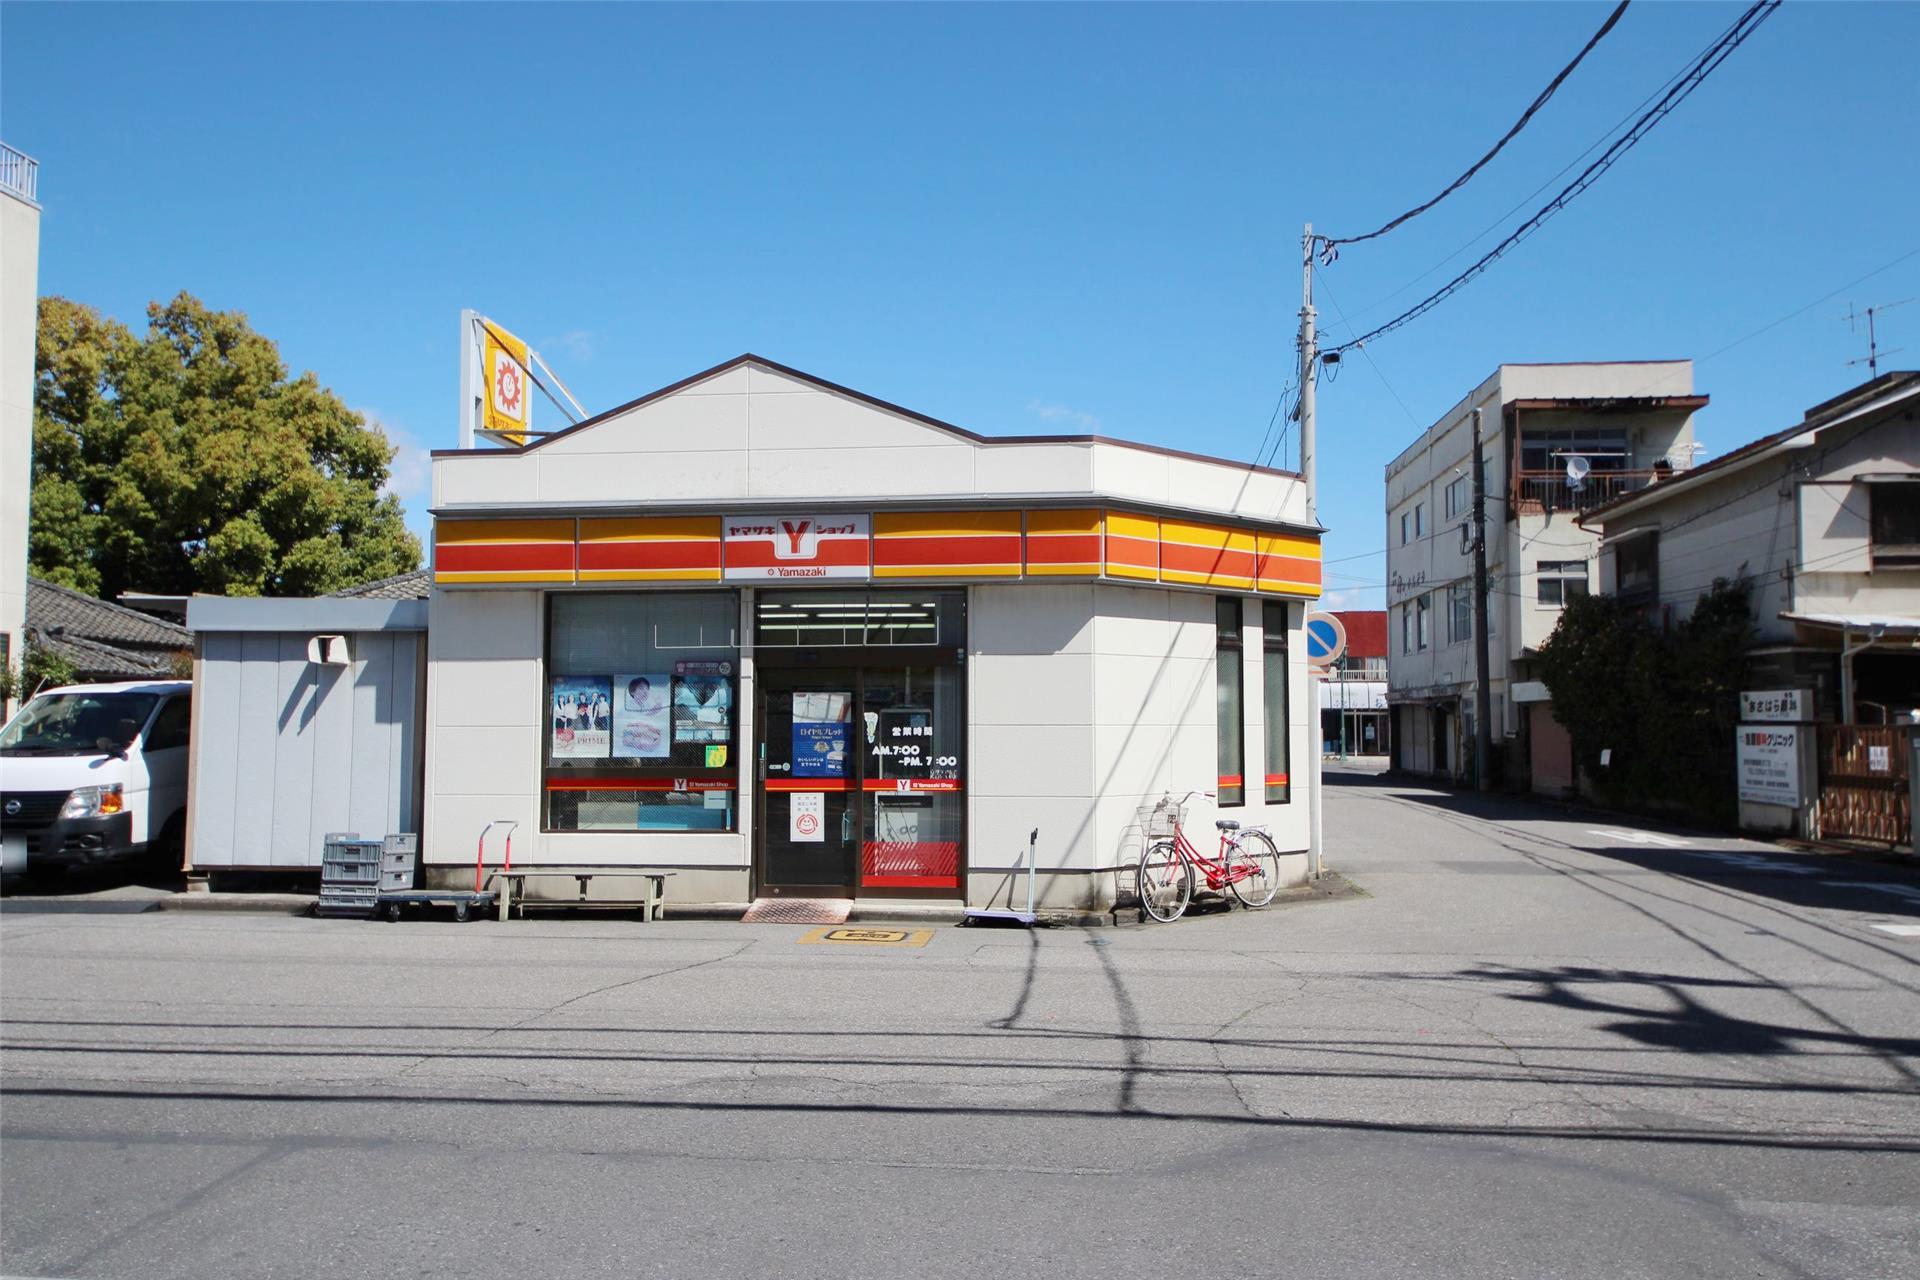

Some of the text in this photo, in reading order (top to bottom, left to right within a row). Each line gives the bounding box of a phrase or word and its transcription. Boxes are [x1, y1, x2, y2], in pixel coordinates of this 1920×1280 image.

[816, 523, 856, 535] ショップ
[781, 520, 811, 553] Y
[777, 567, 826, 577] Yamazaki
[892, 726, 933, 737] 営業時間
